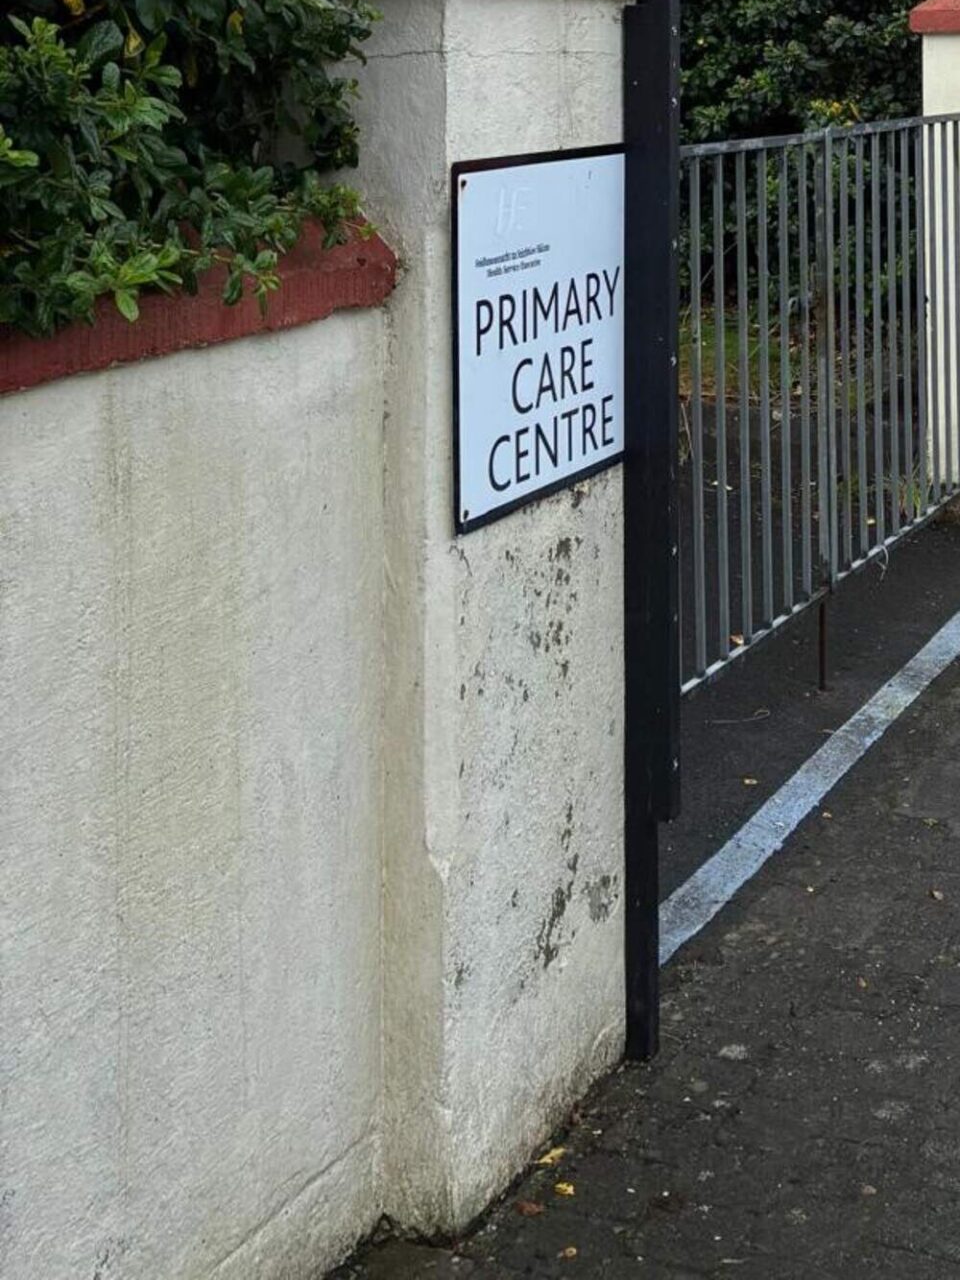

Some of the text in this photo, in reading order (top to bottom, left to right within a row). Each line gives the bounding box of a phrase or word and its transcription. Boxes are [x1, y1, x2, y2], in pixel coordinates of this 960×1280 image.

[475, 265, 621, 357] PRIMARY
[511, 337, 595, 415] CARE
[488, 393, 615, 493] CENTRE
